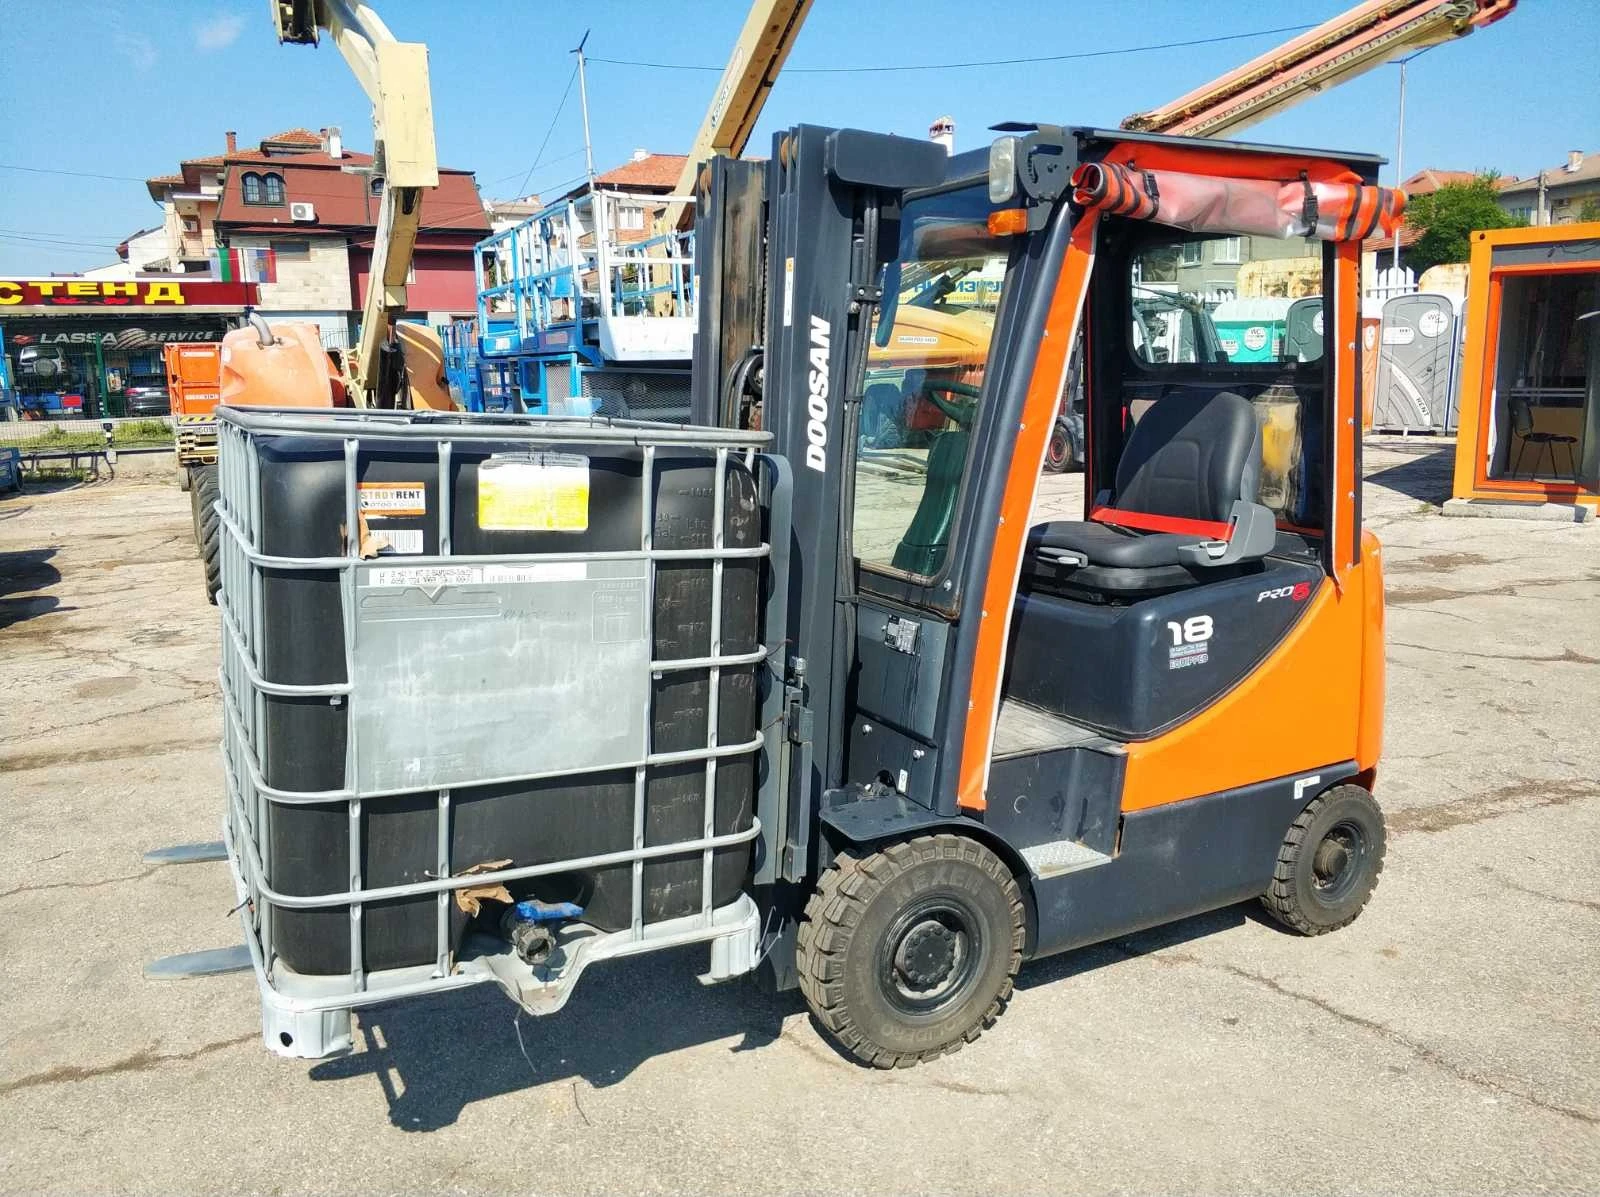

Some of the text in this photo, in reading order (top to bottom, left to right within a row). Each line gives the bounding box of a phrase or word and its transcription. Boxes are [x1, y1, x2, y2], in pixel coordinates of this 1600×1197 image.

[40, 331, 214, 344] LASSA SERVICE
[806, 314, 831, 473] DOOSAN
[1167, 614, 1214, 646] 18
